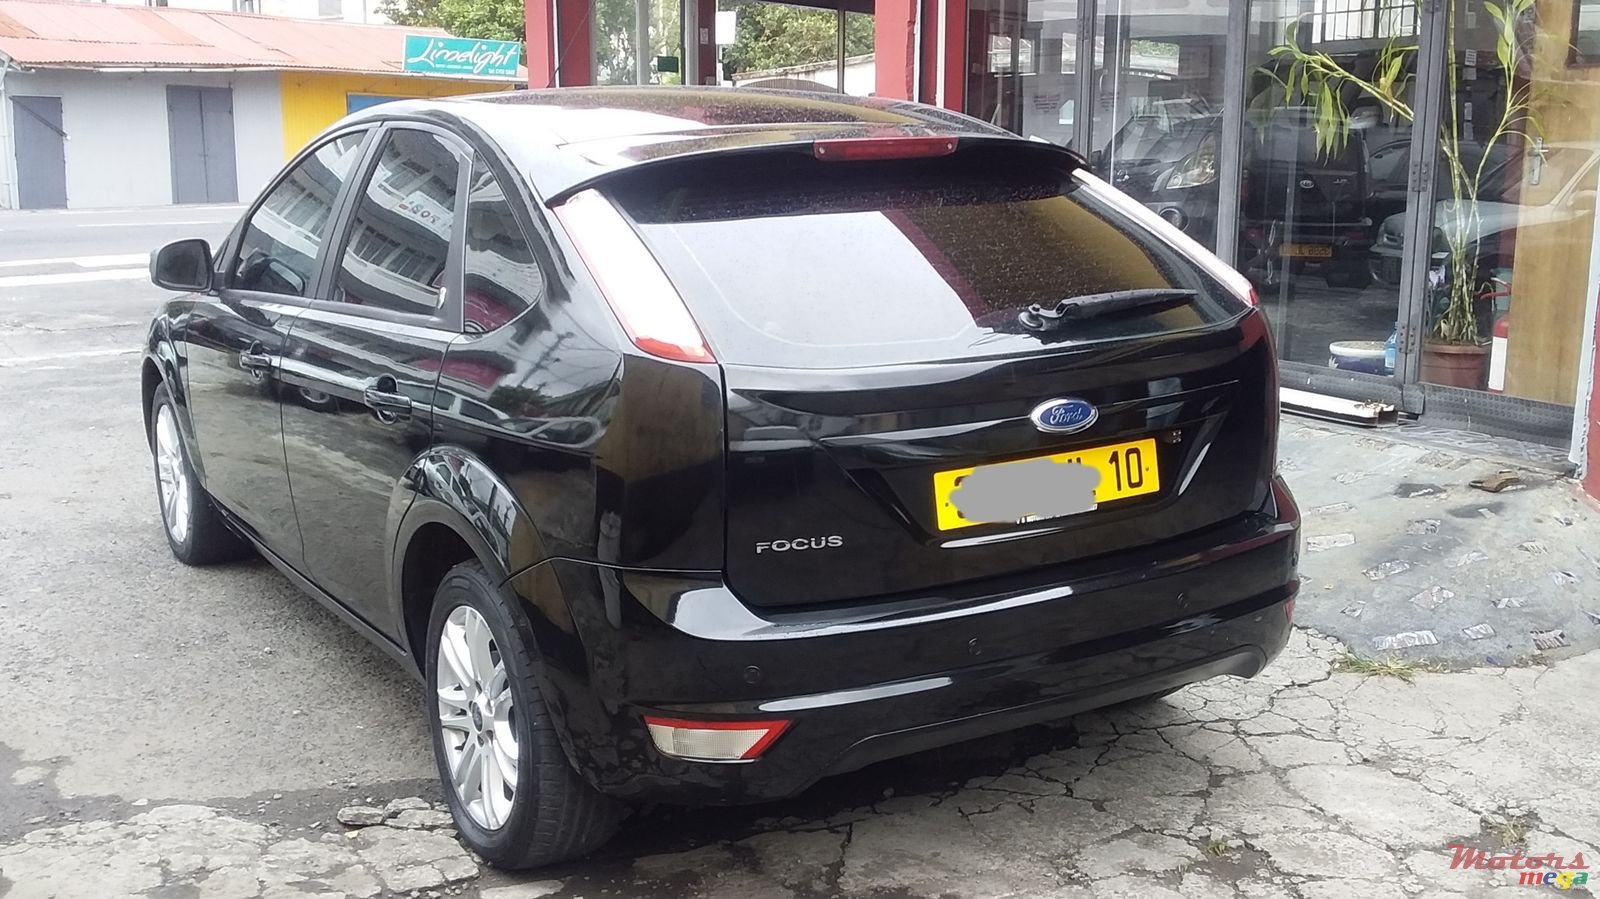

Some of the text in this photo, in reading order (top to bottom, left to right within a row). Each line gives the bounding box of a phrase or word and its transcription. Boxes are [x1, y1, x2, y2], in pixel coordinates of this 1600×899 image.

[407, 38, 518, 73] Limelight
[1050, 404, 1083, 425] Ford
[1108, 447, 1144, 492] 10
[756, 535, 843, 554] FOCUS
